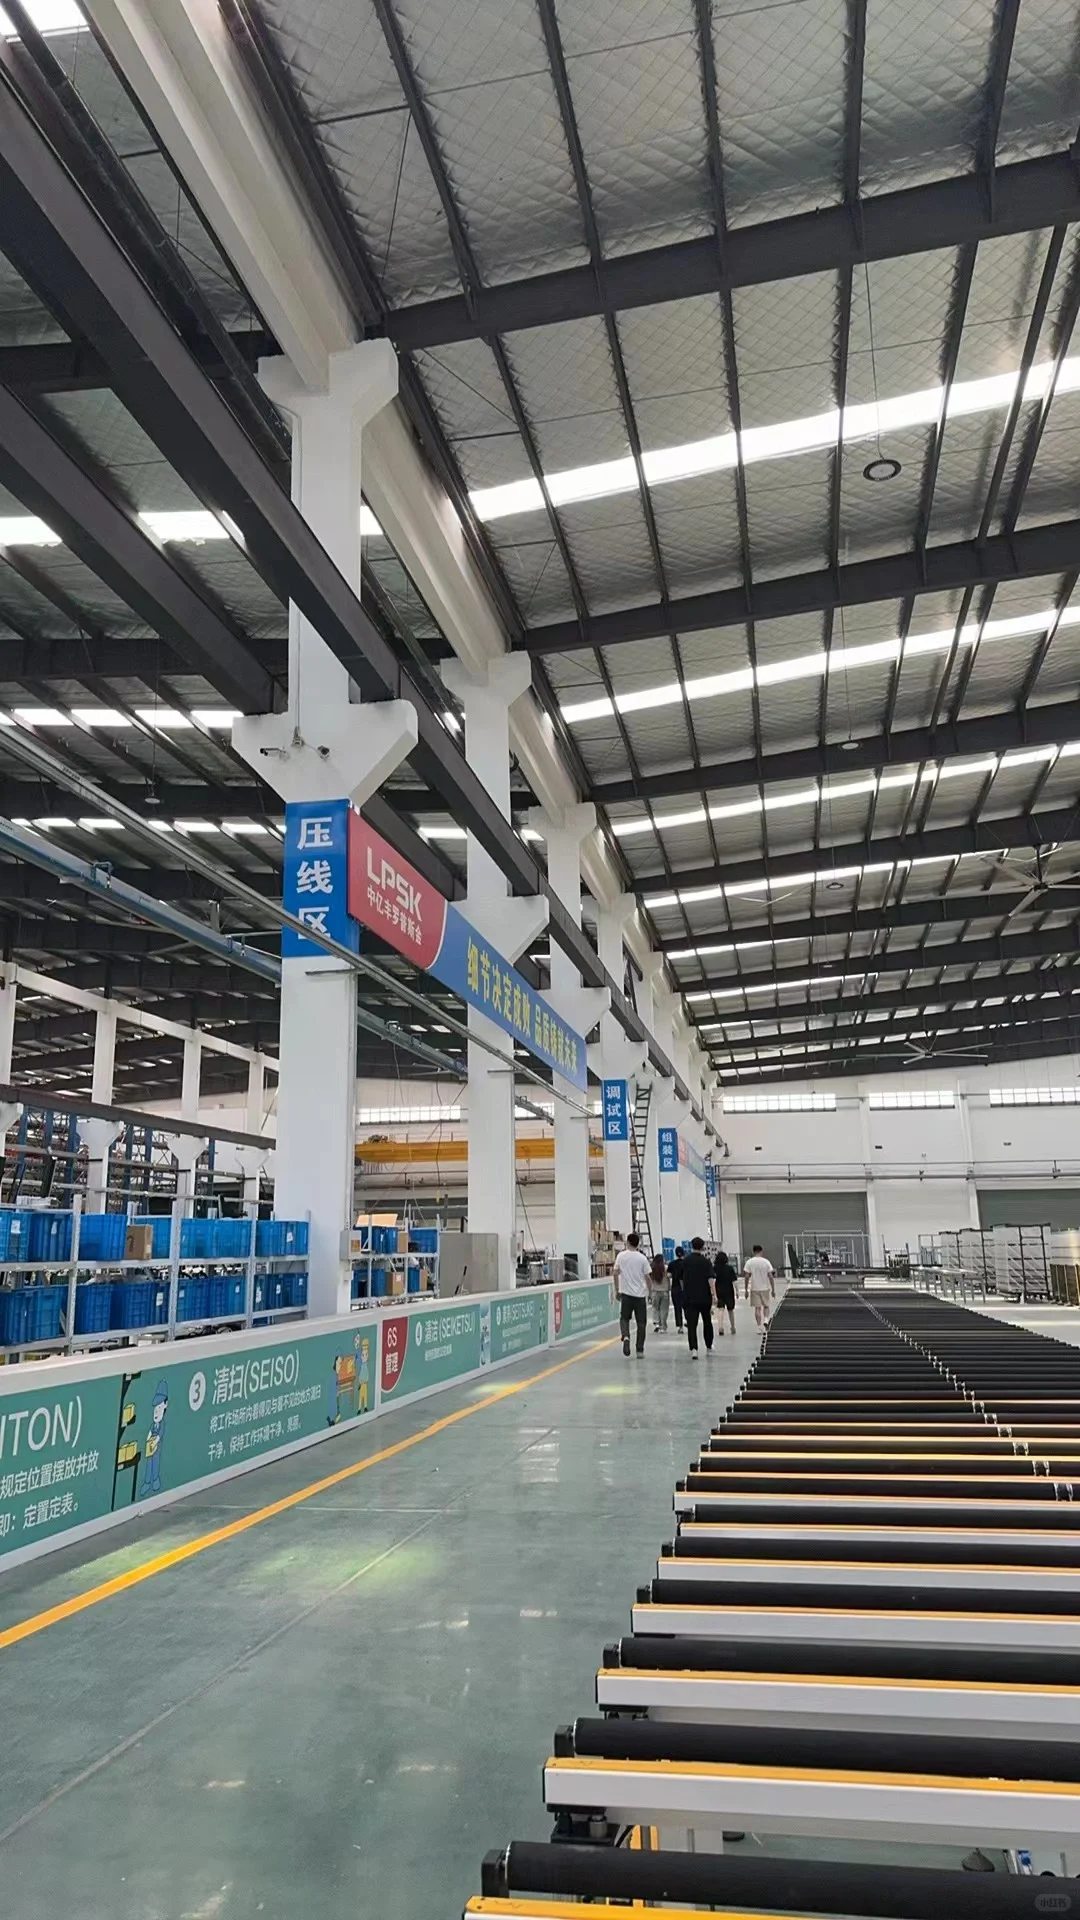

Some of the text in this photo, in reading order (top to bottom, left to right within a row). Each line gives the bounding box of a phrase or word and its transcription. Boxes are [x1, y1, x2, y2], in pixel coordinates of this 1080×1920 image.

[296, 816, 333, 940] 压线区
[367, 846, 422, 921] LPSK
[606, 1086, 621, 1134] 调试区
[662, 1132, 673, 1168] 组装区
[387, 1327, 398, 1348] 6S
[212, 1350, 299, 1405] 清扫(SEISO)
